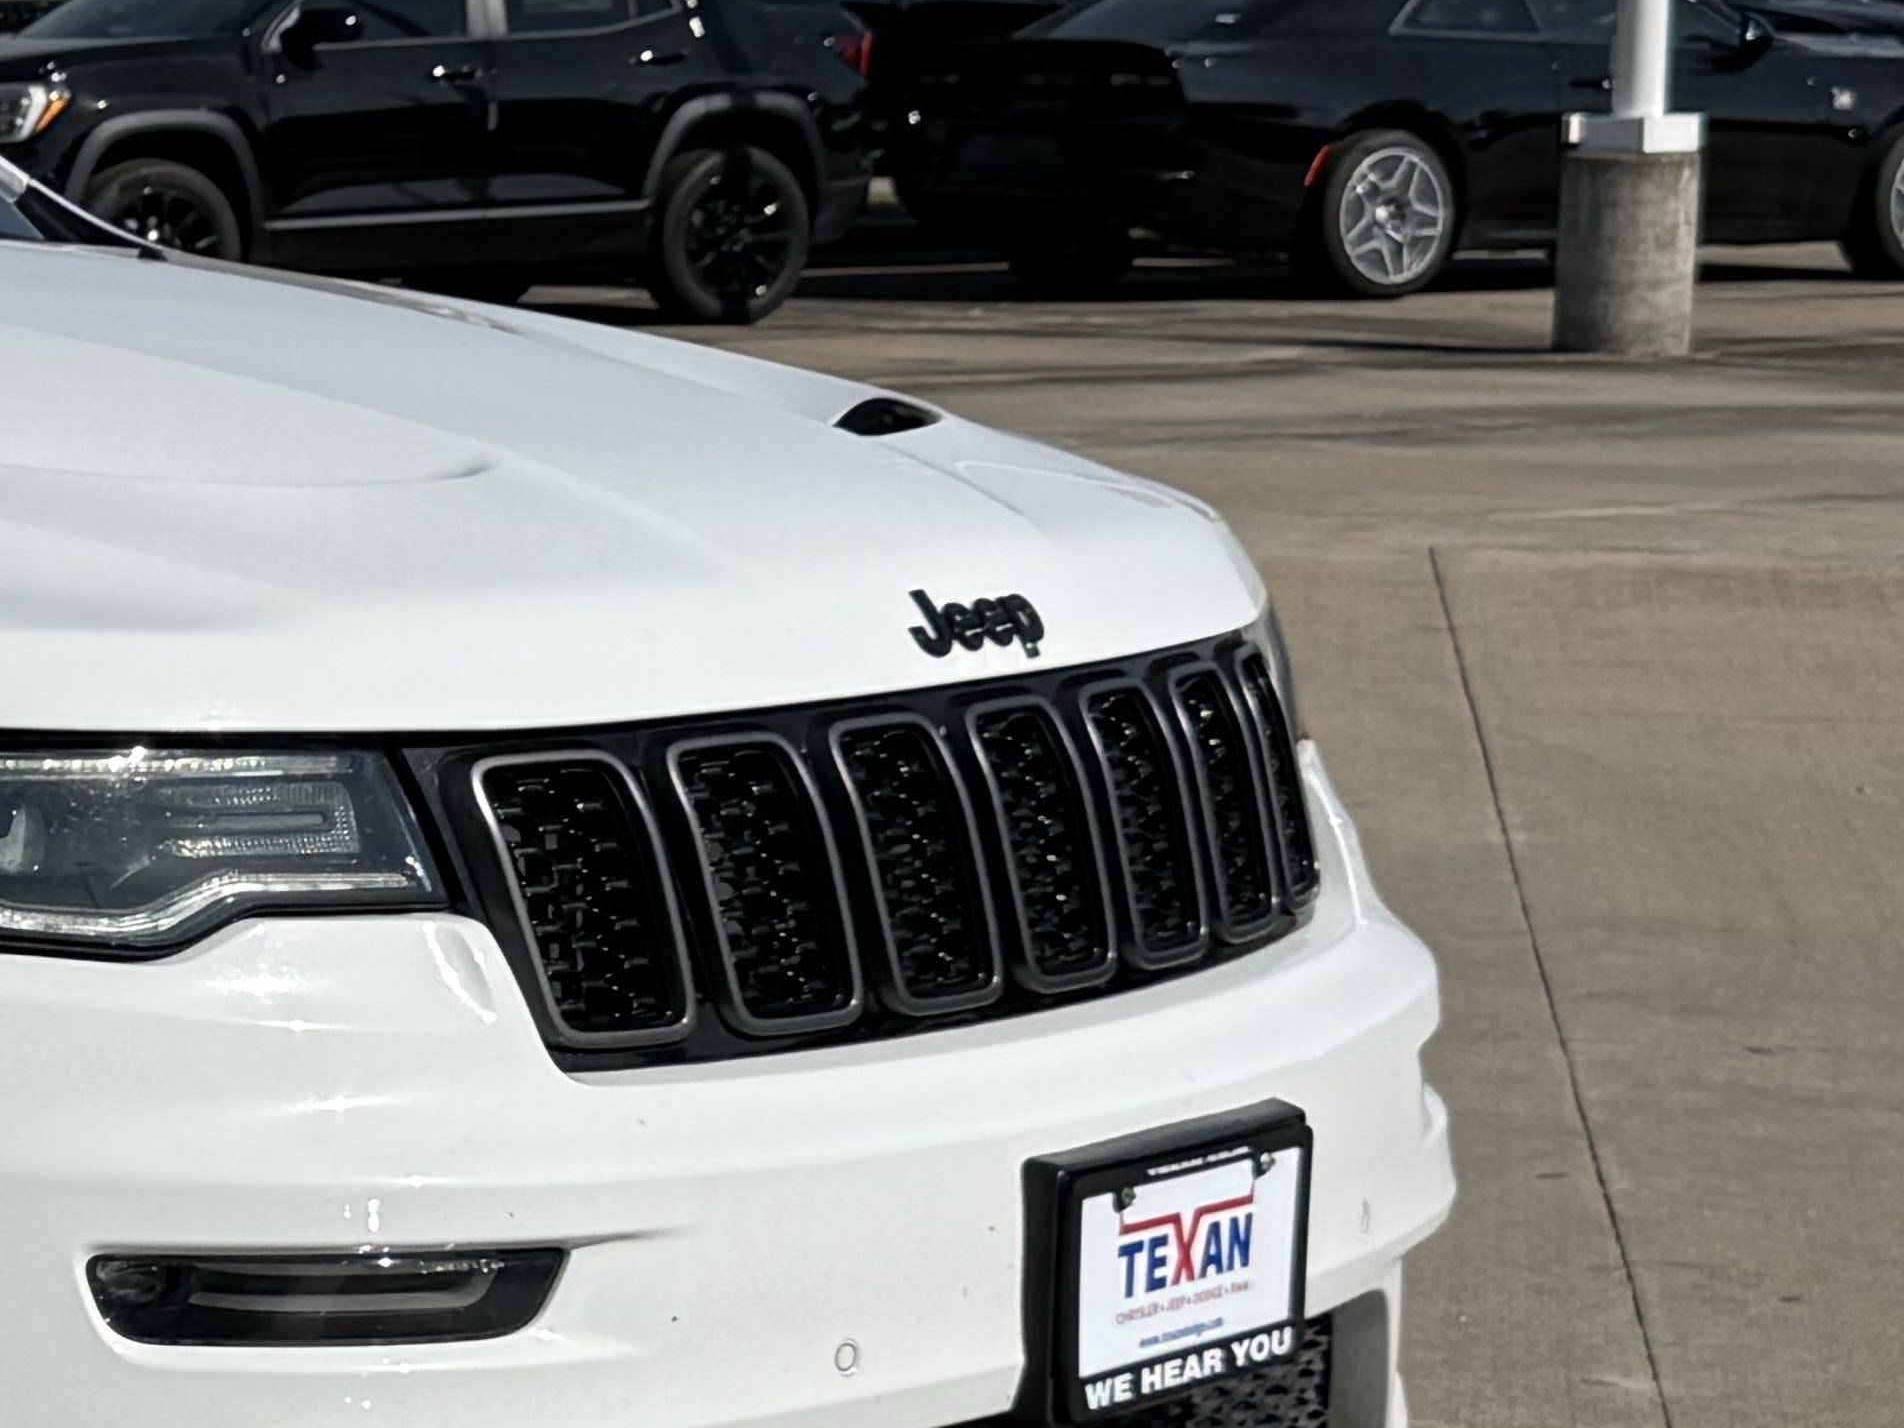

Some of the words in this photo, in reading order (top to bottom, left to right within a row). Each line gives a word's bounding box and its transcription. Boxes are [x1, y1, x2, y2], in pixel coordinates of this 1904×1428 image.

[908, 588, 1045, 659] Jeep
[1117, 1206, 1254, 1300] TEXAN
[1085, 1374, 1132, 1411] WE
[1140, 1348, 1227, 1395] HEAR
[1230, 1326, 1294, 1369] YOU
